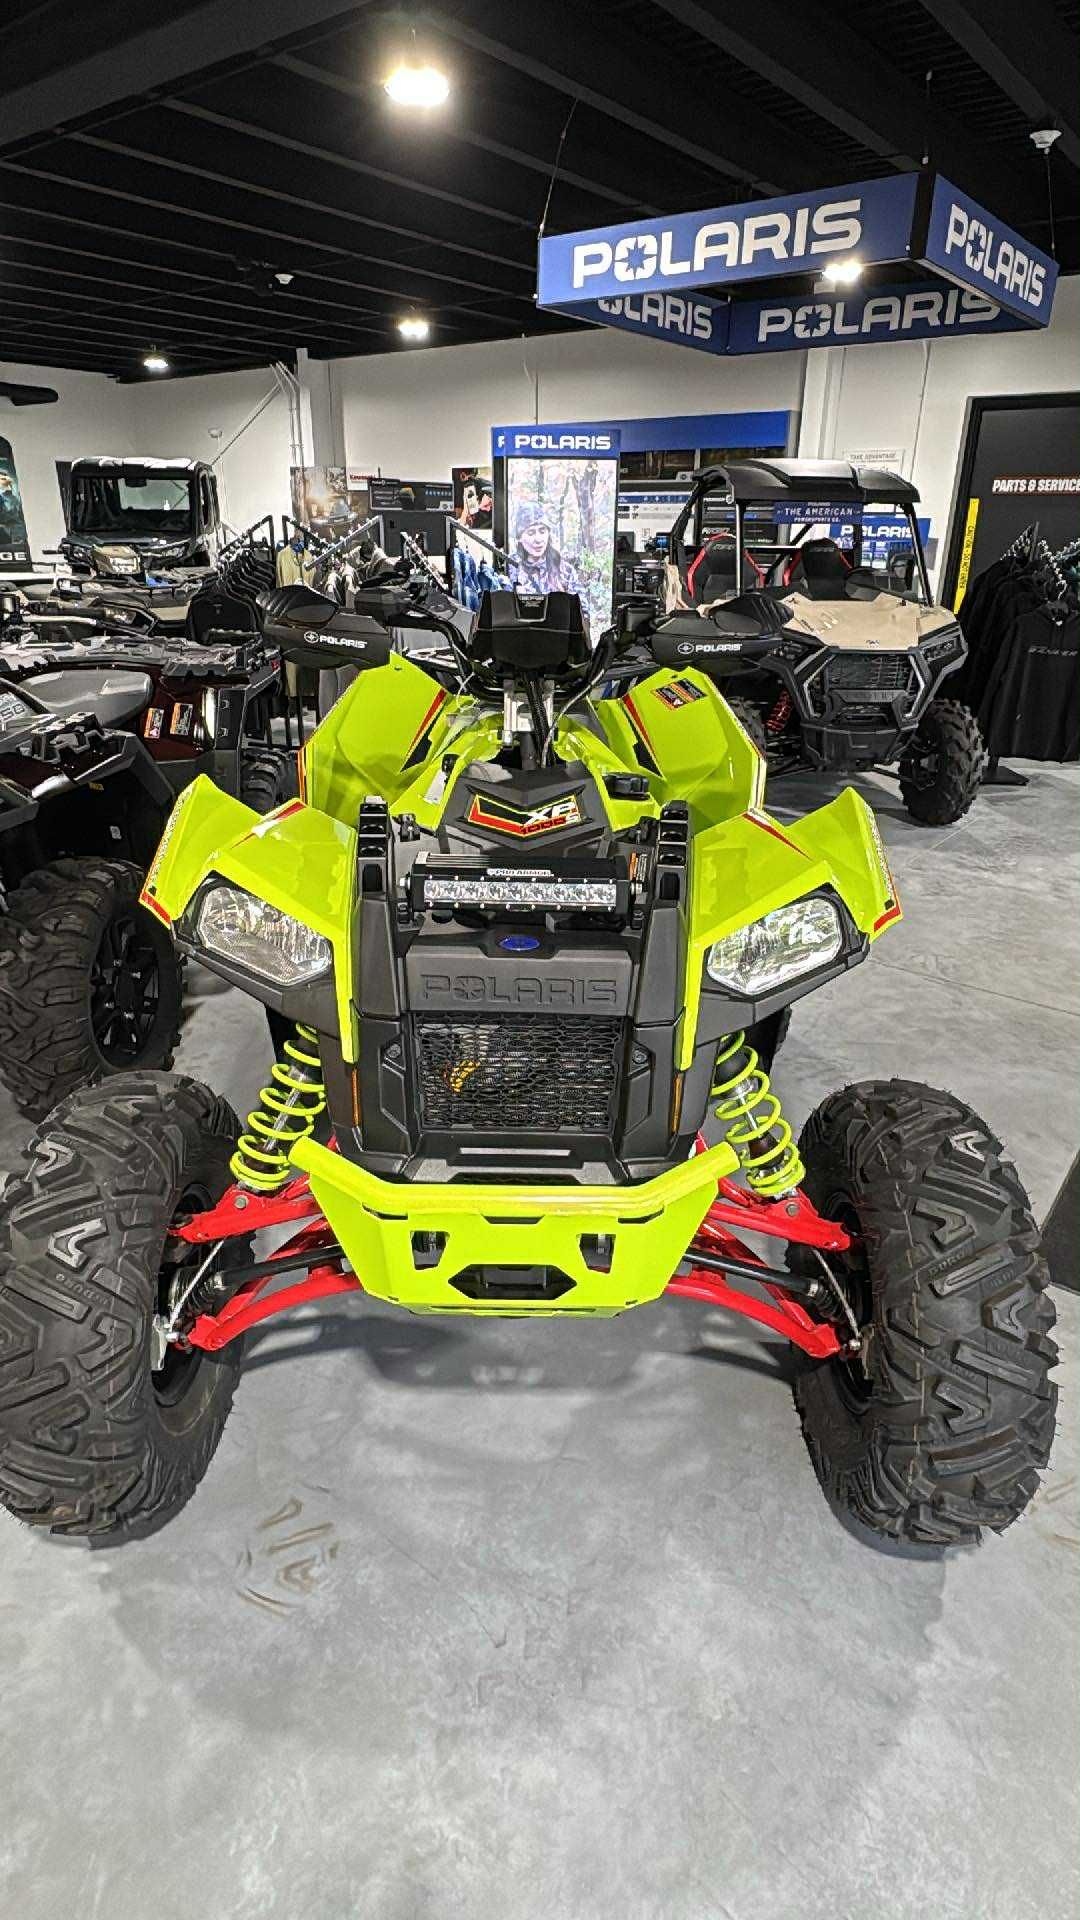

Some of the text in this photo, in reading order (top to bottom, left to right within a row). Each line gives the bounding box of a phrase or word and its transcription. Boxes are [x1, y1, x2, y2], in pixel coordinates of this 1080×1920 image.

[573, 199, 862, 288] POLARIS
[945, 203, 1046, 307] POLARIS
[514, 434, 612, 450] POLARIS
[992, 479, 1027, 492] PARTS
[1028, 479, 1037, 492] &
[784, 507, 802, 516] THE
[805, 507, 853, 516] AMERICAN
[320, 635, 367, 649] POLARIS
[696, 643, 742, 653] POLARIS
[525, 801, 577, 826] XP
[519, 815, 567, 834] 1000
[421, 974, 617, 1006] POLARIS
